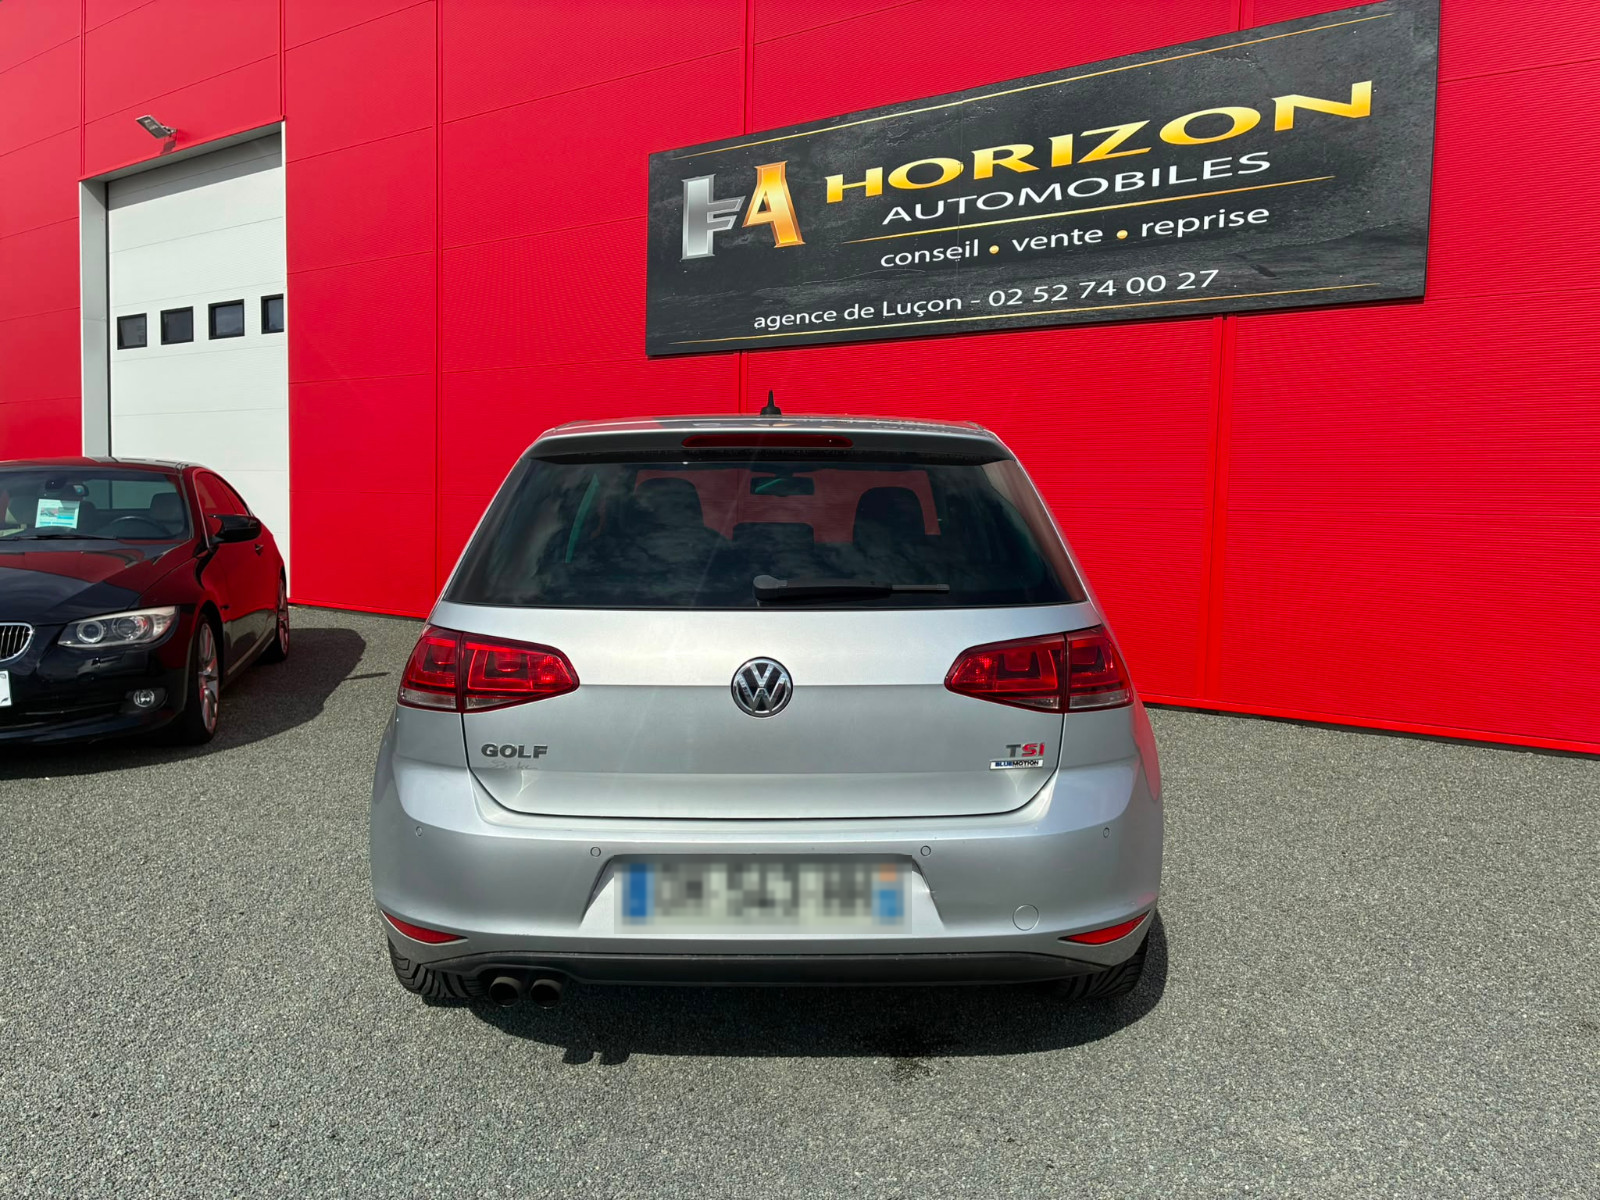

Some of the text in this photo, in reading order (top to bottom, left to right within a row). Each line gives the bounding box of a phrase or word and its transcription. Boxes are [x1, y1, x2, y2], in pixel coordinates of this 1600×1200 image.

[824, 80, 1372, 203] HORIZON
[882, 151, 1271, 225] AUTOMOBILES
[880, 208, 1270, 268] conseil vente reprise
[753, 309, 837, 331] agence
[843, 303, 875, 320] de
[882, 295, 962, 318] Luçon
[988, 288, 1023, 308] 02
[1032, 284, 1068, 303] 52
[1079, 279, 1116, 299] 74
[1126, 275, 1166, 294] 00
[1176, 269, 1219, 290] 27
[481, 743, 548, 759] GOLF
[1006, 742, 1045, 758] TSI
